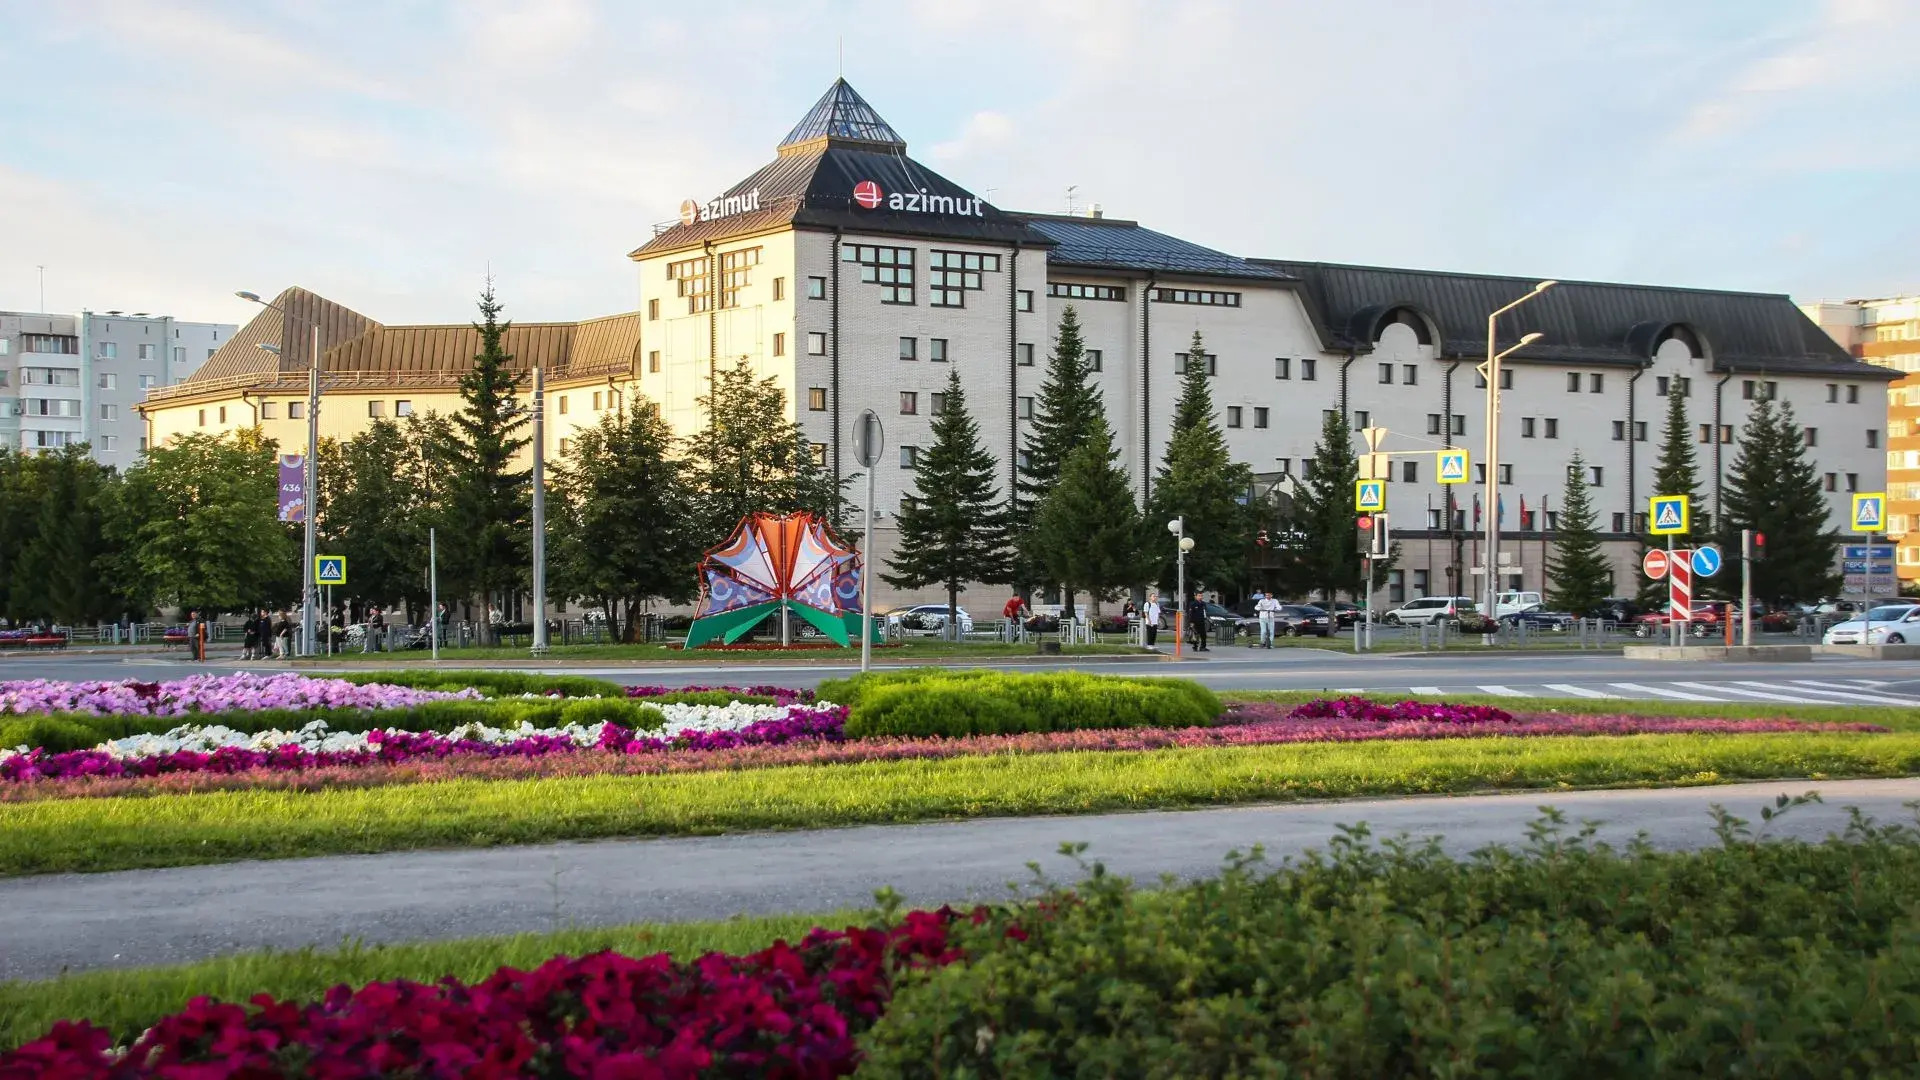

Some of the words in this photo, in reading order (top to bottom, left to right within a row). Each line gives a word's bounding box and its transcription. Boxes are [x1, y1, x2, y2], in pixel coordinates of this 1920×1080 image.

[699, 187, 760, 222] azimut
[889, 187, 983, 217] azimut
[282, 484, 301, 492] 436
